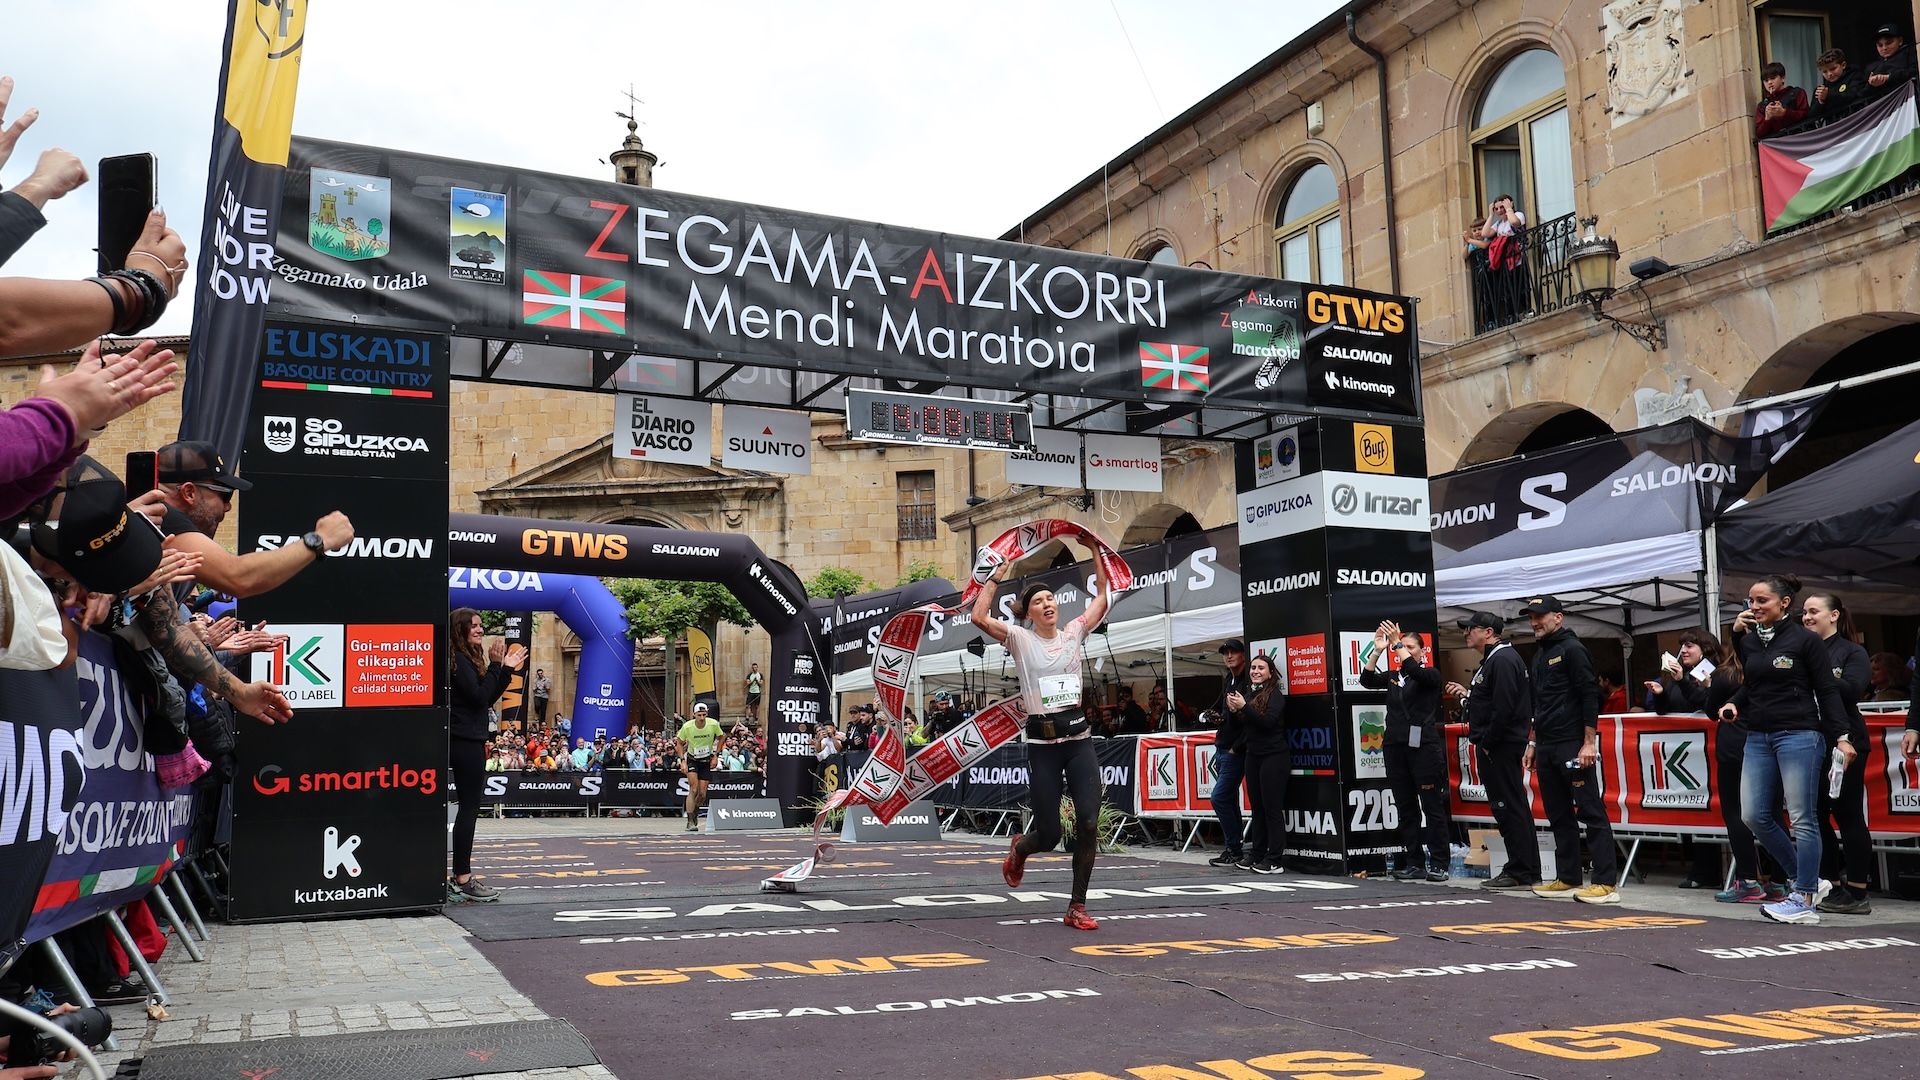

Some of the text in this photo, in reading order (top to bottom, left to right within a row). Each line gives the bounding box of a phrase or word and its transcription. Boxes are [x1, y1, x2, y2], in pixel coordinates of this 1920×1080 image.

[272, 255, 428, 291] Zegamako Udala
[453, 268, 502, 278] AMEZTI
[585, 201, 1168, 329] ZEGAMA-AIZKORRI
[1247, 289, 1297, 309] Aizkorri
[1307, 290, 1404, 334] GTWS
[683, 280, 1096, 373] Mendi Maratoia
[1221, 312, 1272, 332] Zegama
[265, 328, 430, 366] EUSKADI
[1232, 343, 1300, 360] maratoia
[1323, 345, 1393, 366] SALOMON
[263, 361, 432, 387] BASQUE COUNTRY
[1342, 374, 1395, 397] kinomap
[632, 397, 653, 414] EL
[305, 418, 342, 433] SO
[631, 414, 695, 436] DIARIO
[303, 433, 429, 452] GIPUZKOA
[632, 431, 693, 452] VASCO
[728, 437, 806, 458] SUUNTO
[304, 447, 396, 459] SAN SEBASTIÁN
[1010, 451, 1075, 465] SALOMON
[1105, 457, 1158, 473] smartlog
[1611, 462, 1736, 497] SALOMON
[1256, 494, 1312, 518] GIPUZKOA
[1364, 491, 1422, 516] Irizar
[522, 528, 628, 560] GTWS
[652, 543, 720, 557] SALOMON
[1120, 568, 1178, 593] ALOMON
[1247, 570, 1321, 597] SALOMON
[1336, 568, 1427, 588] SALOMON
[760, 575, 797, 616] kinomap
[350, 639, 431, 653] Goi-mailako
[834, 638, 863, 655] SALOMON
[1288, 645, 1325, 657] Goi-mailako
[357, 654, 424, 670] elikagaiak
[794, 659, 813, 669] HBO
[794, 667, 812, 675] max
[1292, 656, 1322, 668] elikagaiak
[359, 672, 422, 682] Alimentos de
[1058, 681, 1065, 690] 7
[301, 689, 336, 700] LABEL
[352, 683, 429, 695] calidad superior
[583, 696, 624, 707] GIPUZKOA
[783, 711, 819, 724] TRAIL
[299, 763, 437, 795] smartlog
[519, 782, 571, 790] SALOMON
[618, 782, 668, 790] SALOMON
[707, 783, 754, 791] SALOMON
[1645, 794, 1705, 805] EUSKO LABEL
[732, 809, 776, 819] kinomap
[1349, 789, 1399, 832] 226
[862, 815, 929, 826] SAOMON
[1282, 810, 1337, 836] ULMA
[294, 883, 388, 903] kutxabank
[579, 927, 839, 945] SALOMON
[1697, 936, 1919, 961] SALOMON
[584, 952, 990, 987] GTWS
[1295, 958, 1578, 983] SALOMON
[730, 987, 1102, 1021] SALOMON
